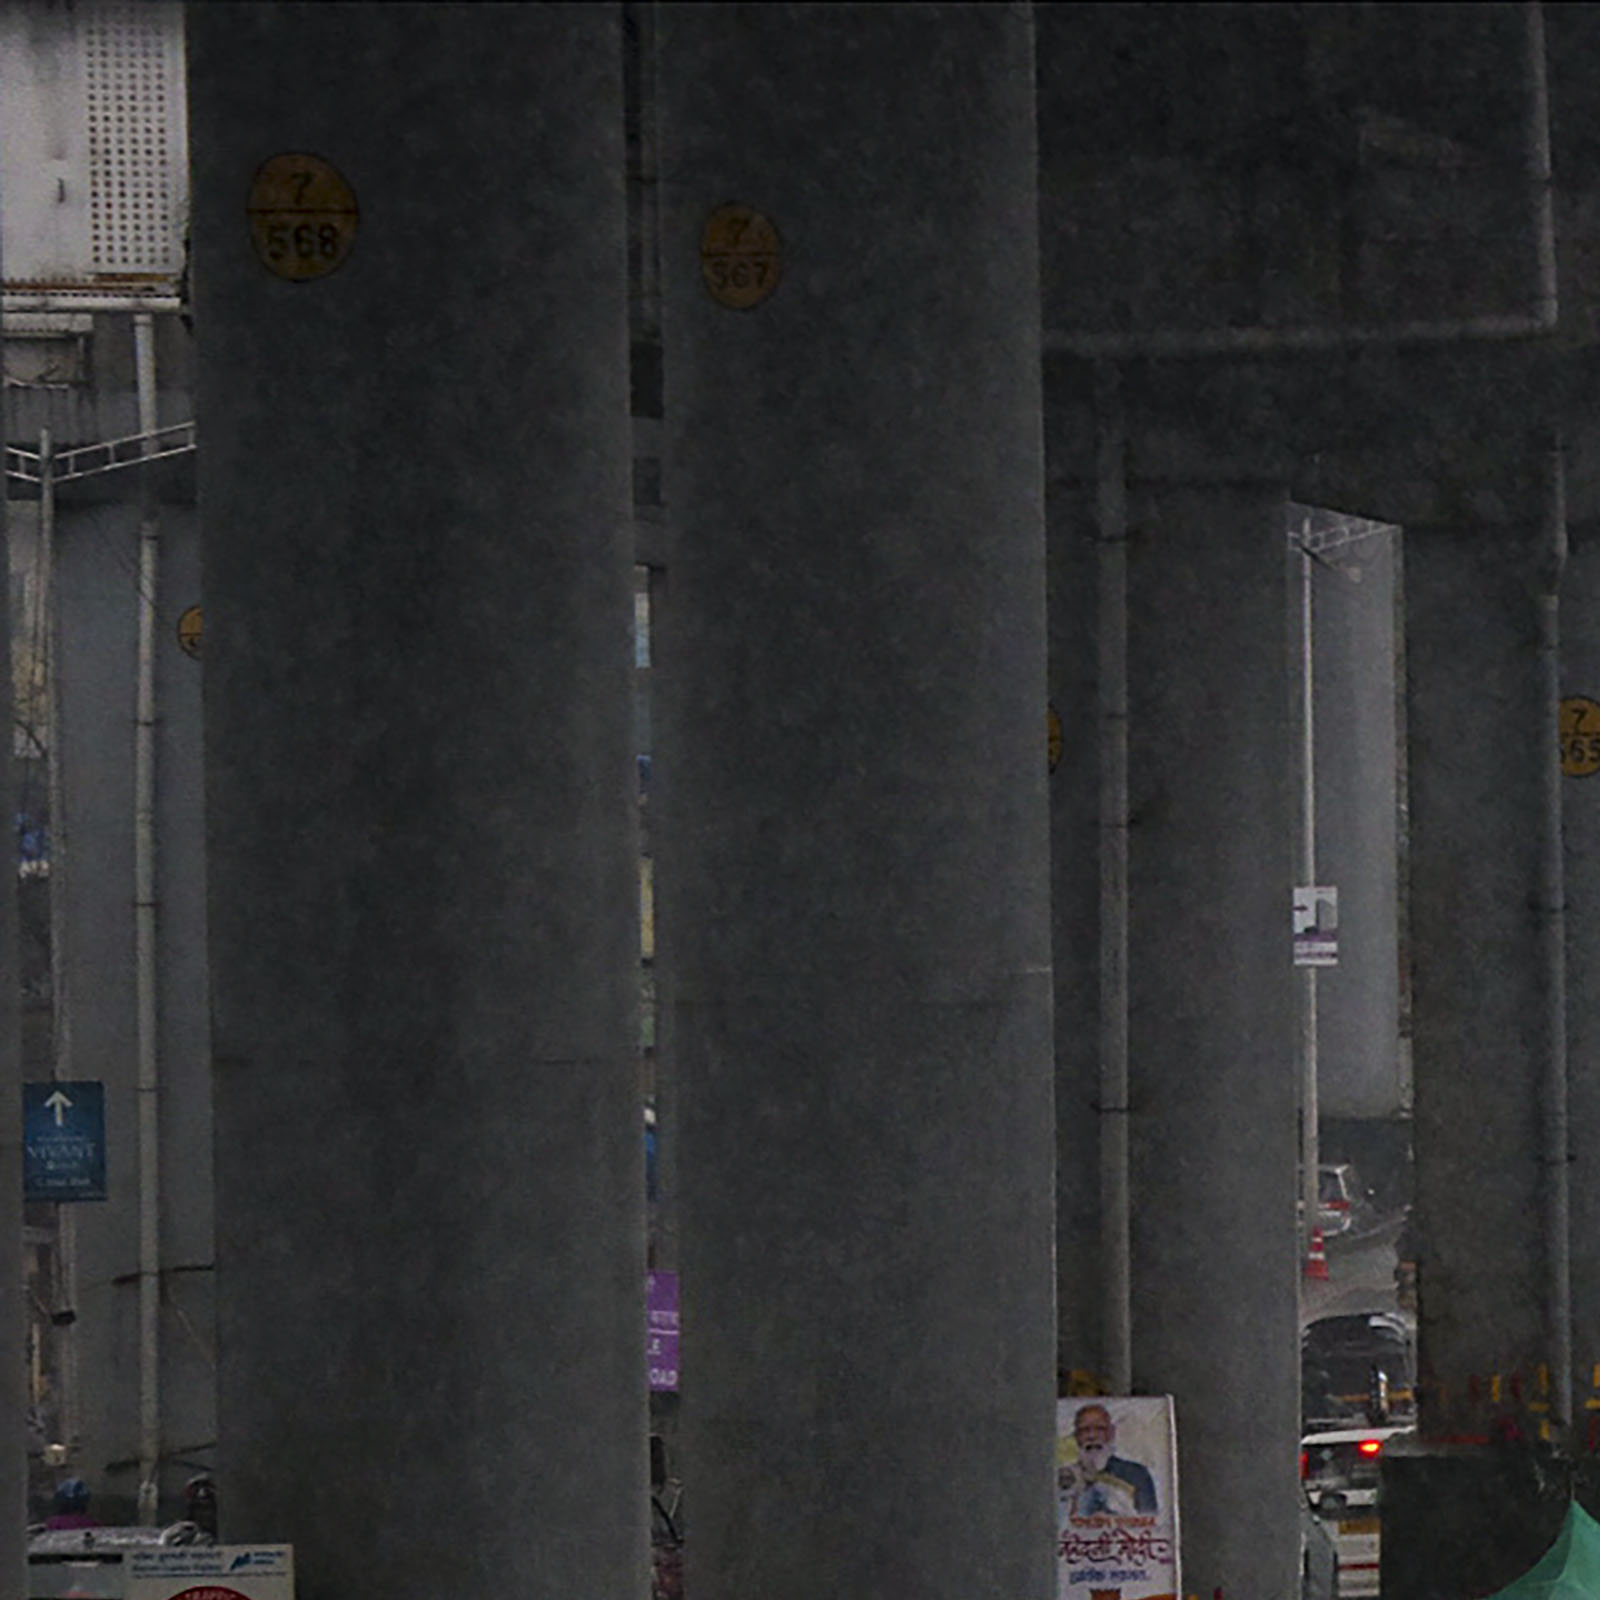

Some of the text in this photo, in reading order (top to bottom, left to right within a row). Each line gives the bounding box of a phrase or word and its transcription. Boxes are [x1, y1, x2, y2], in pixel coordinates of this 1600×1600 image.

[291, 173, 312, 205] 7
[267, 223, 338, 260] 568
[728, 217, 750, 247] 7
[711, 260, 768, 290] 567
[1571, 708, 1587, 732] 7
